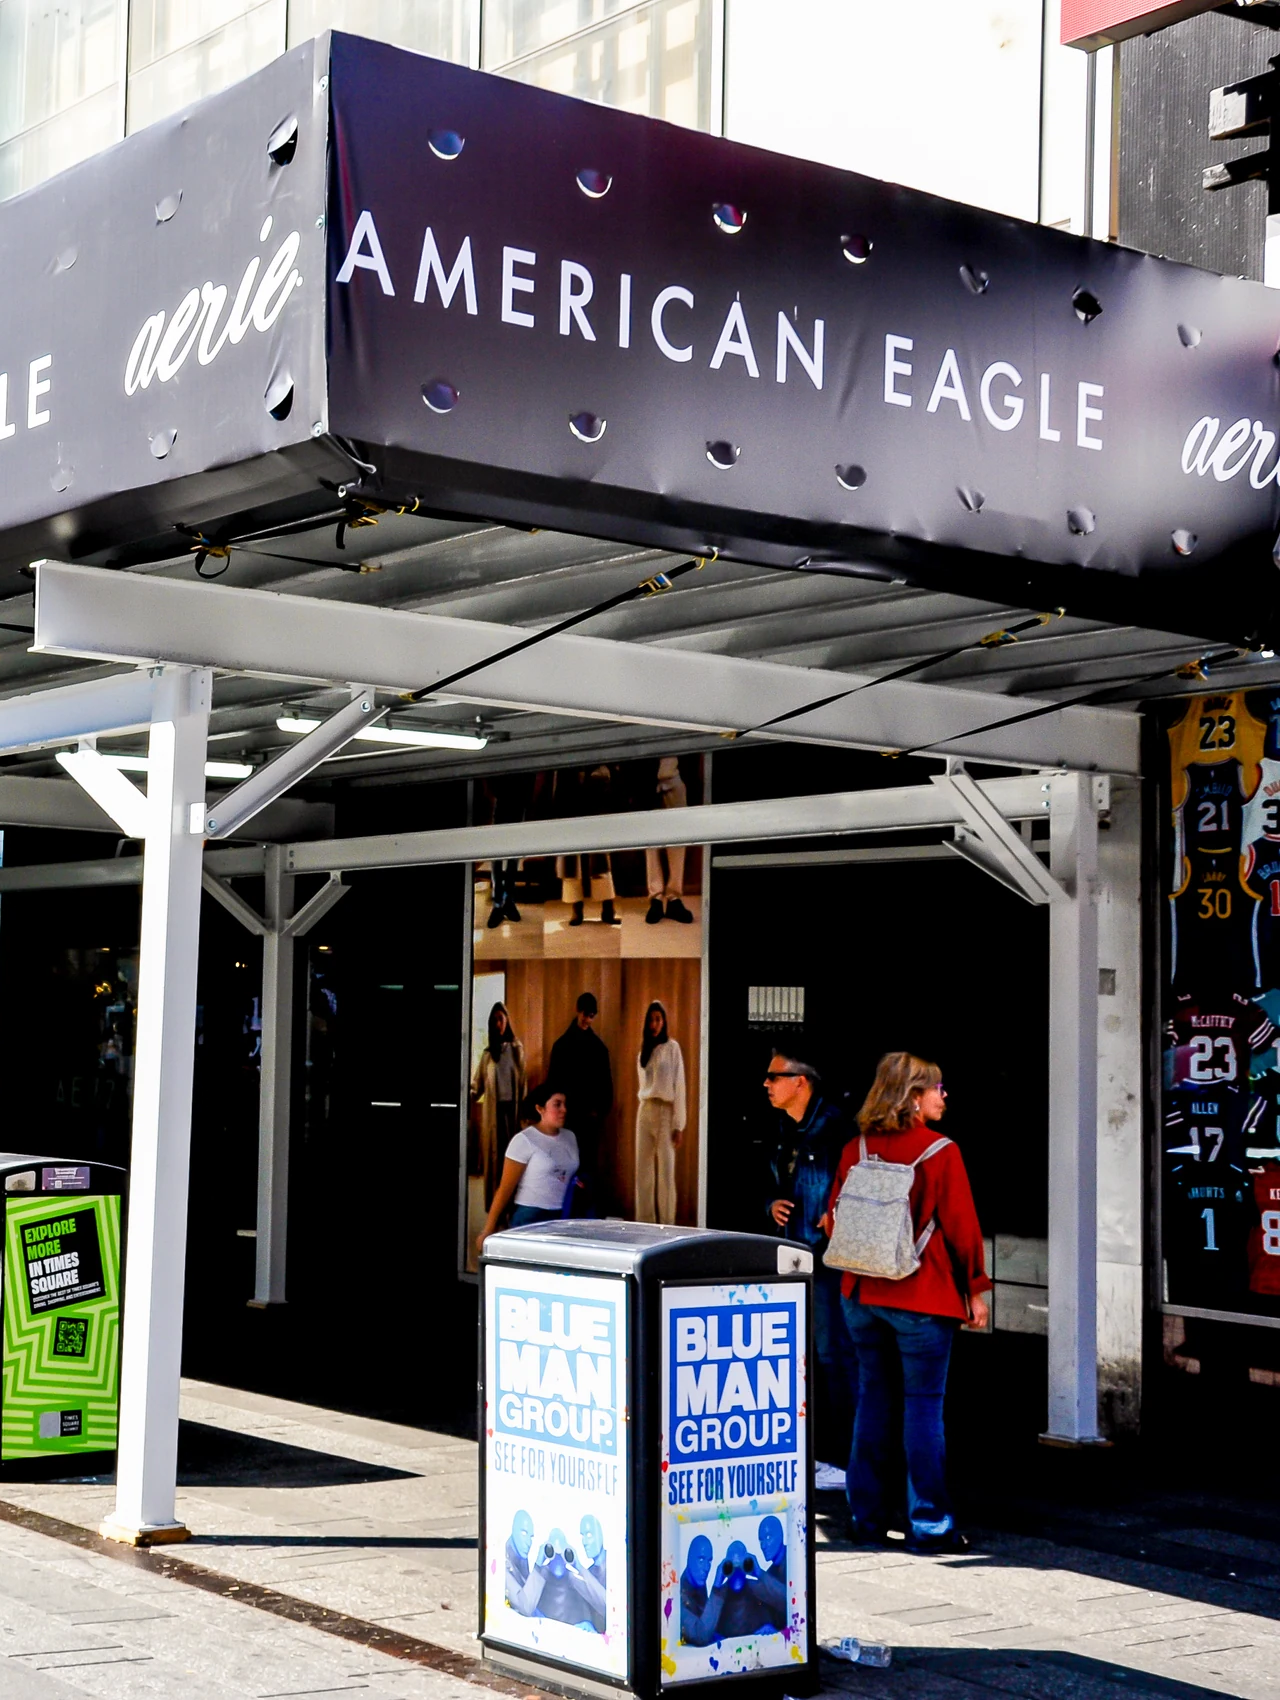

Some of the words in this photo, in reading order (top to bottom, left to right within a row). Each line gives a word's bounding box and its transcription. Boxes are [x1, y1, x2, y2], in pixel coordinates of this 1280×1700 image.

[124, 215, 304, 396] aerie
[336, 211, 824, 390] AMERICAN
[884, 333, 1105, 451] EAGLE
[1181, 416, 1280, 490] aer
[1199, 715, 1236, 752] 23
[1197, 801, 1230, 832] 21
[1197, 888, 1232, 919] 30
[1189, 1035, 1237, 1081] 23
[1189, 1127, 1224, 1162] 17
[24, 1218, 77, 1244] EXPLORE
[26, 1239, 61, 1261] MORE
[1201, 1208, 1220, 1250] 1
[28, 1261, 43, 1278] IN
[43, 1252, 80, 1274] TIMES
[31, 1269, 80, 1295] SQUARE
[498, 1294, 611, 1355] BLUE
[676, 1311, 790, 1363] BLUE
[499, 1340, 612, 1410] MAN
[676, 1358, 790, 1418] MAN
[499, 1393, 613, 1446] GROUP
[675, 1411, 792, 1455] GROUP
[494, 1440, 517, 1475] SEE
[521, 1445, 546, 1480] FOR
[550, 1453, 618, 1497] YOURSELF
[668, 1467, 694, 1506] SEE
[697, 1464, 724, 1504] FOR
[727, 1459, 798, 1500] YOURSELF
